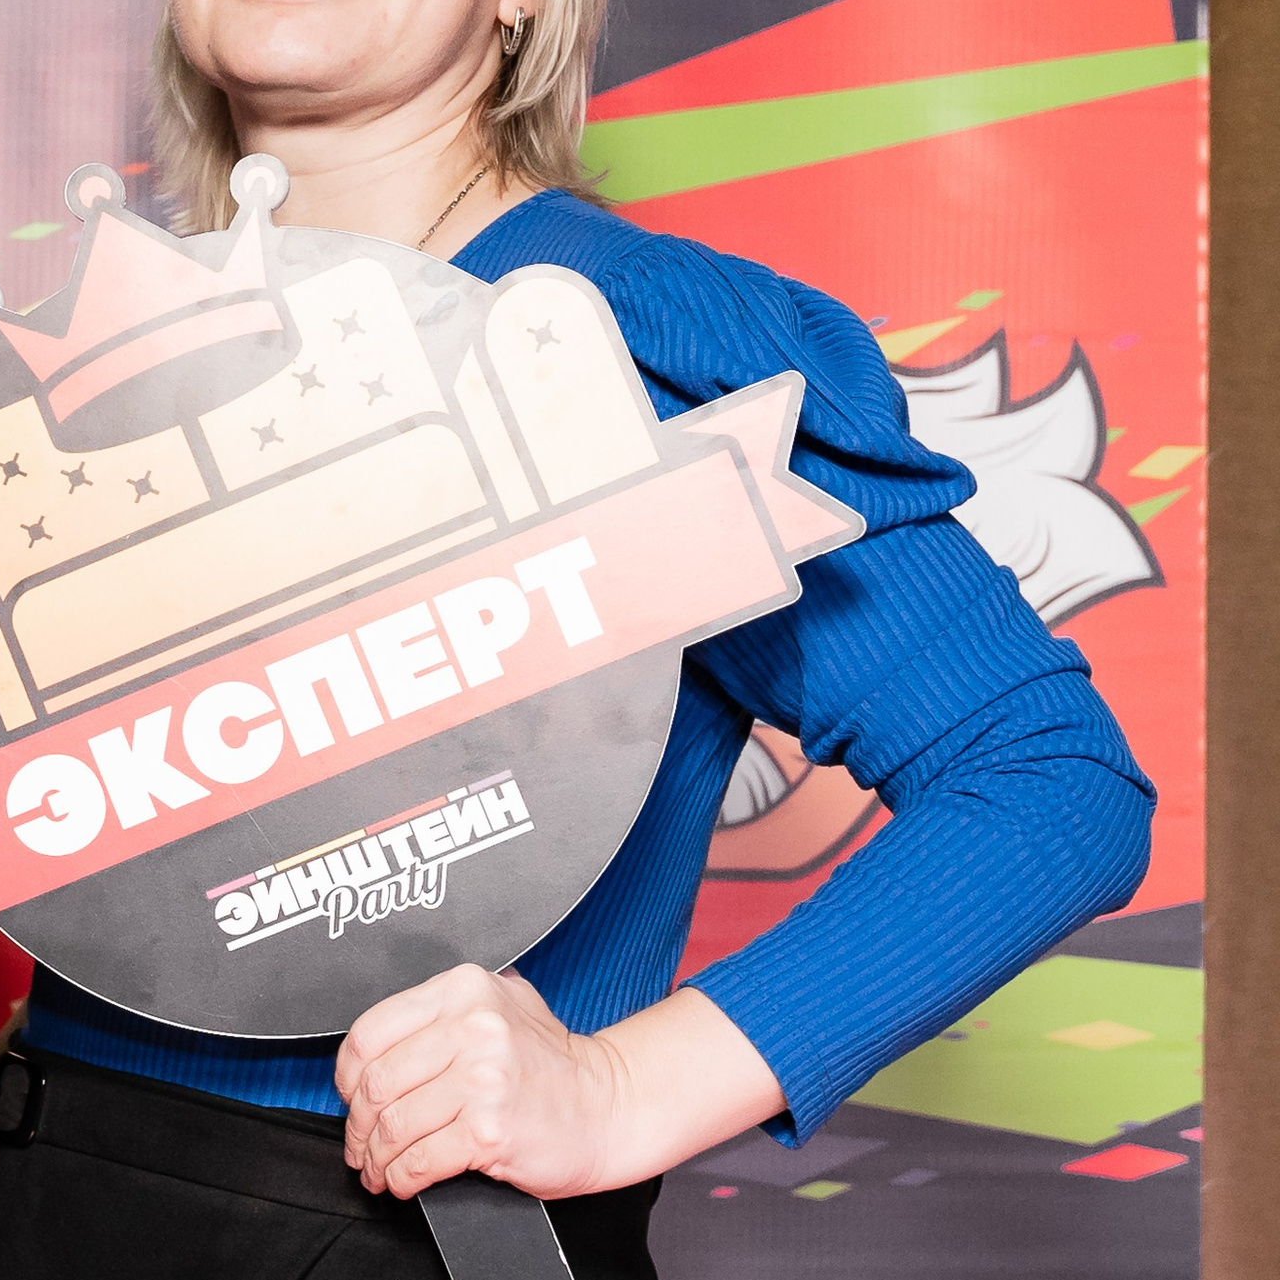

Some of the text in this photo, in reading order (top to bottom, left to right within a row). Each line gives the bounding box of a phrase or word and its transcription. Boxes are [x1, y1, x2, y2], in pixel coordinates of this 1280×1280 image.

[5, 536, 604, 856] ЭКСПЕРТ
[214, 778, 531, 937] ЭЙНШТЕЙН
[321, 856, 448, 940] Party
